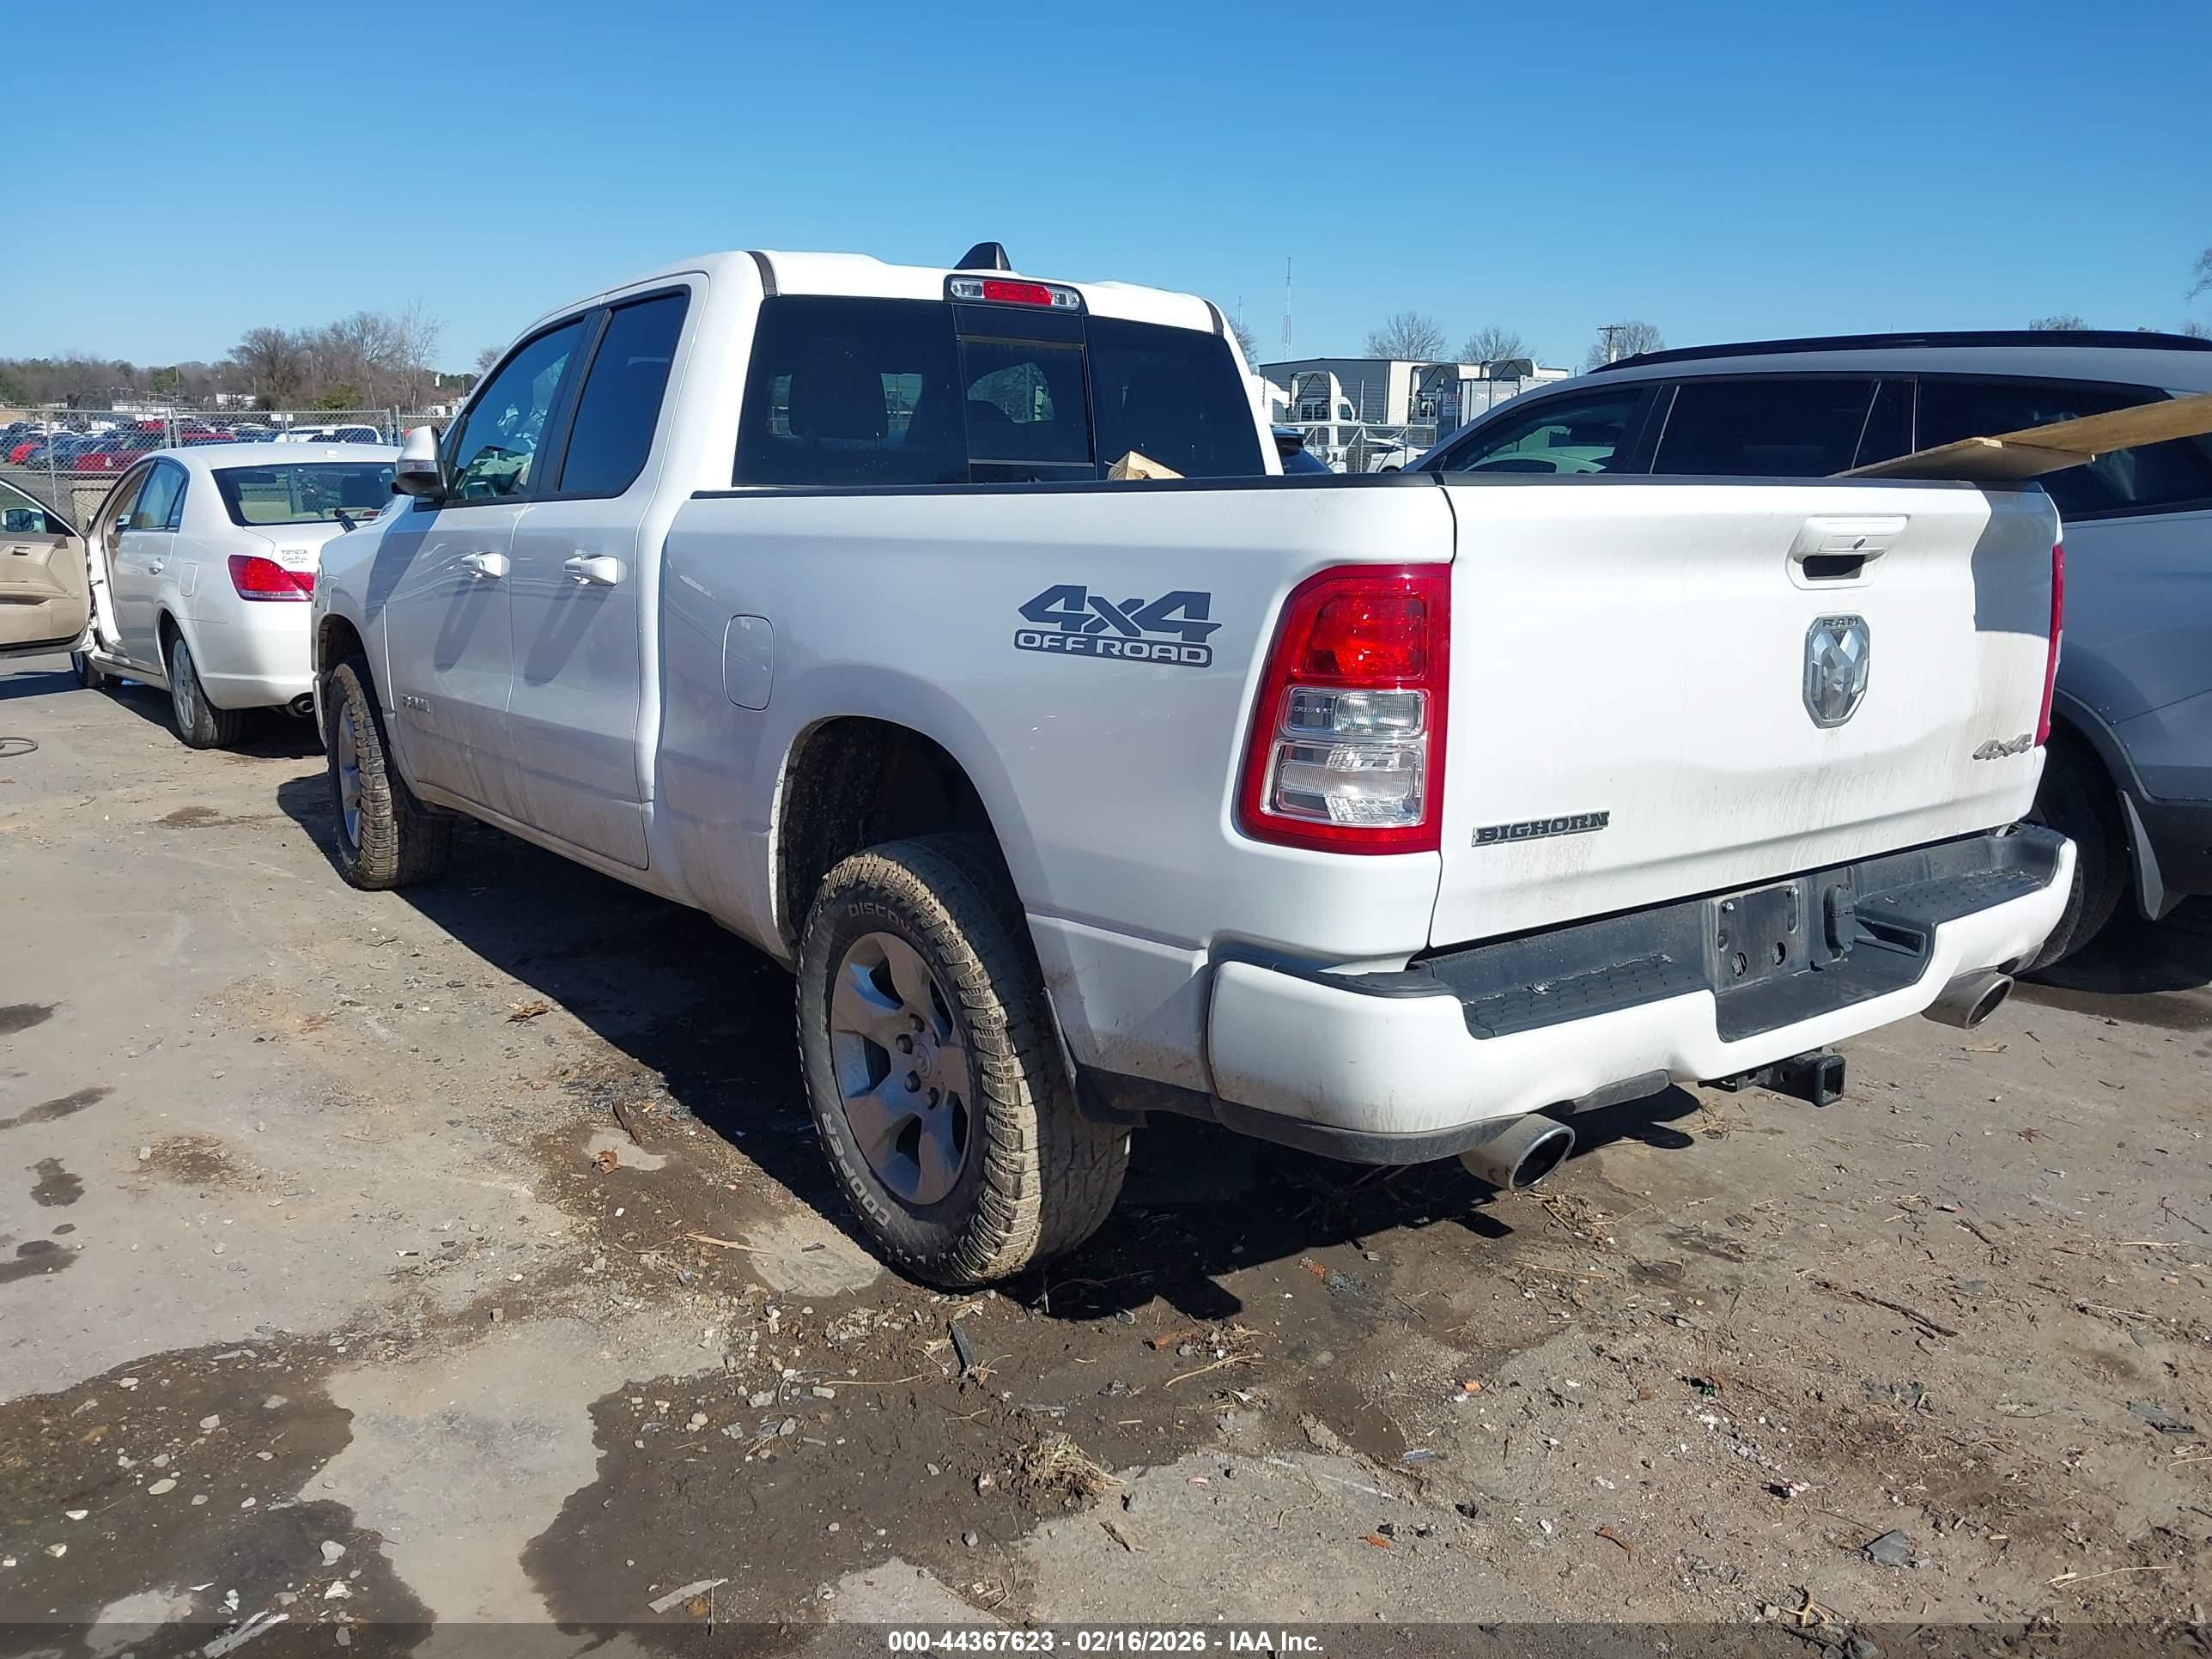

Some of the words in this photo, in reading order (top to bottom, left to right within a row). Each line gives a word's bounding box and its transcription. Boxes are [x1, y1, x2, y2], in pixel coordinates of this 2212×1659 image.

[1822, 617, 1859, 628] RAM
[1017, 632, 1089, 653] OFF
[1095, 638, 1209, 664] ROAD
[1472, 811, 1610, 847] BIGHORN
[821, 1112, 892, 1228] COOPER
